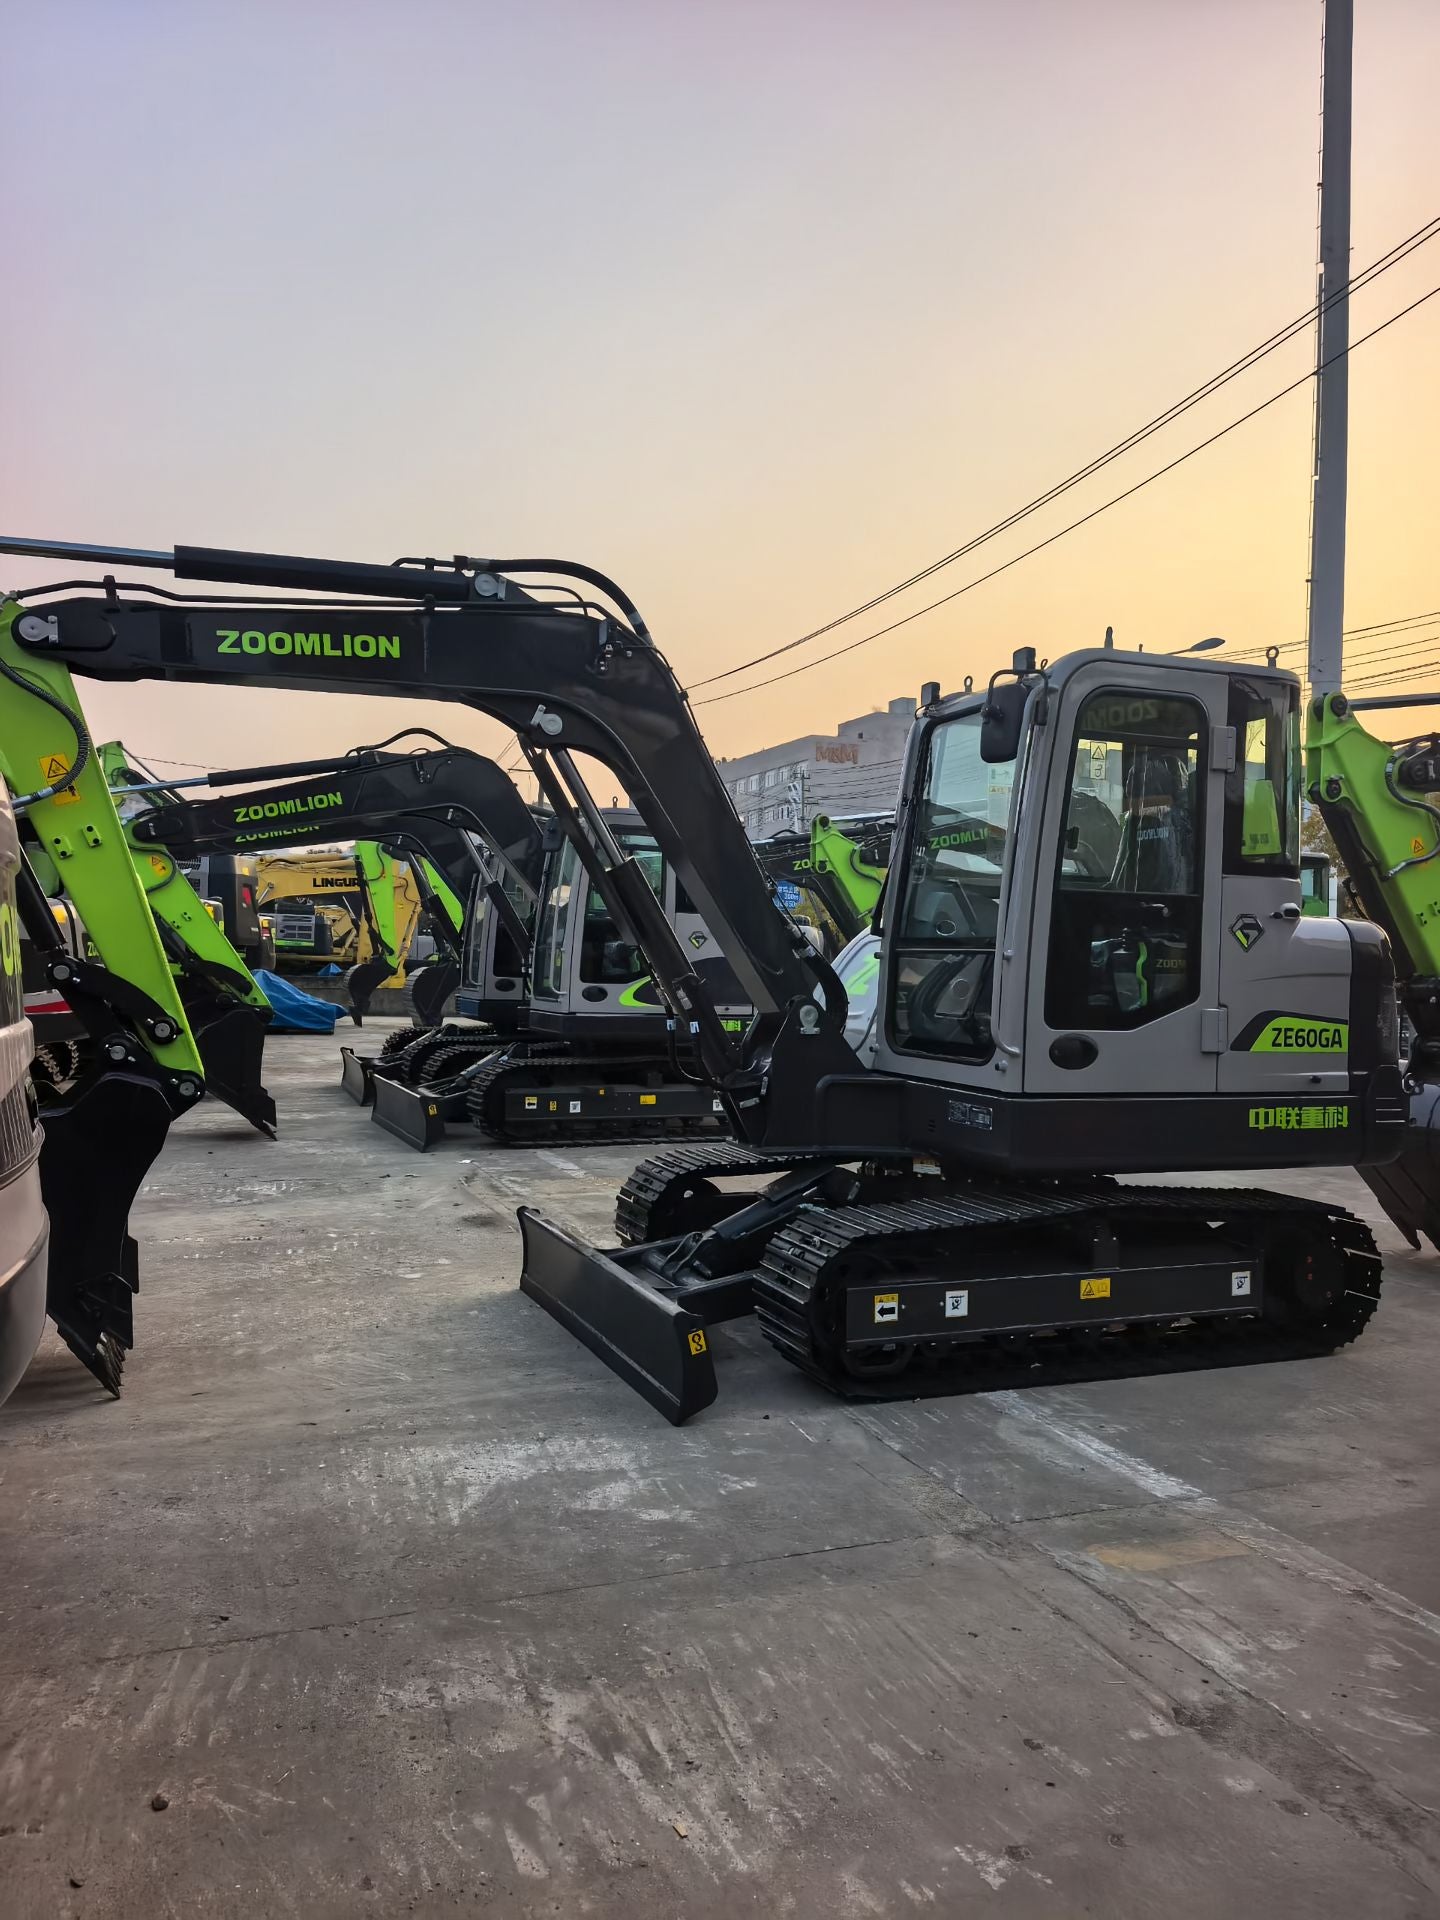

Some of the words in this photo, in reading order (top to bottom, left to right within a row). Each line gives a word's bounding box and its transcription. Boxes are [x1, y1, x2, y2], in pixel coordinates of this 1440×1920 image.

[216, 630, 401, 659] ZOOMLION
[233, 791, 343, 823] ZOOMLION
[1271, 1027, 1343, 1049] ZE60GA
[1249, 1106, 1349, 1130] 中联重科
